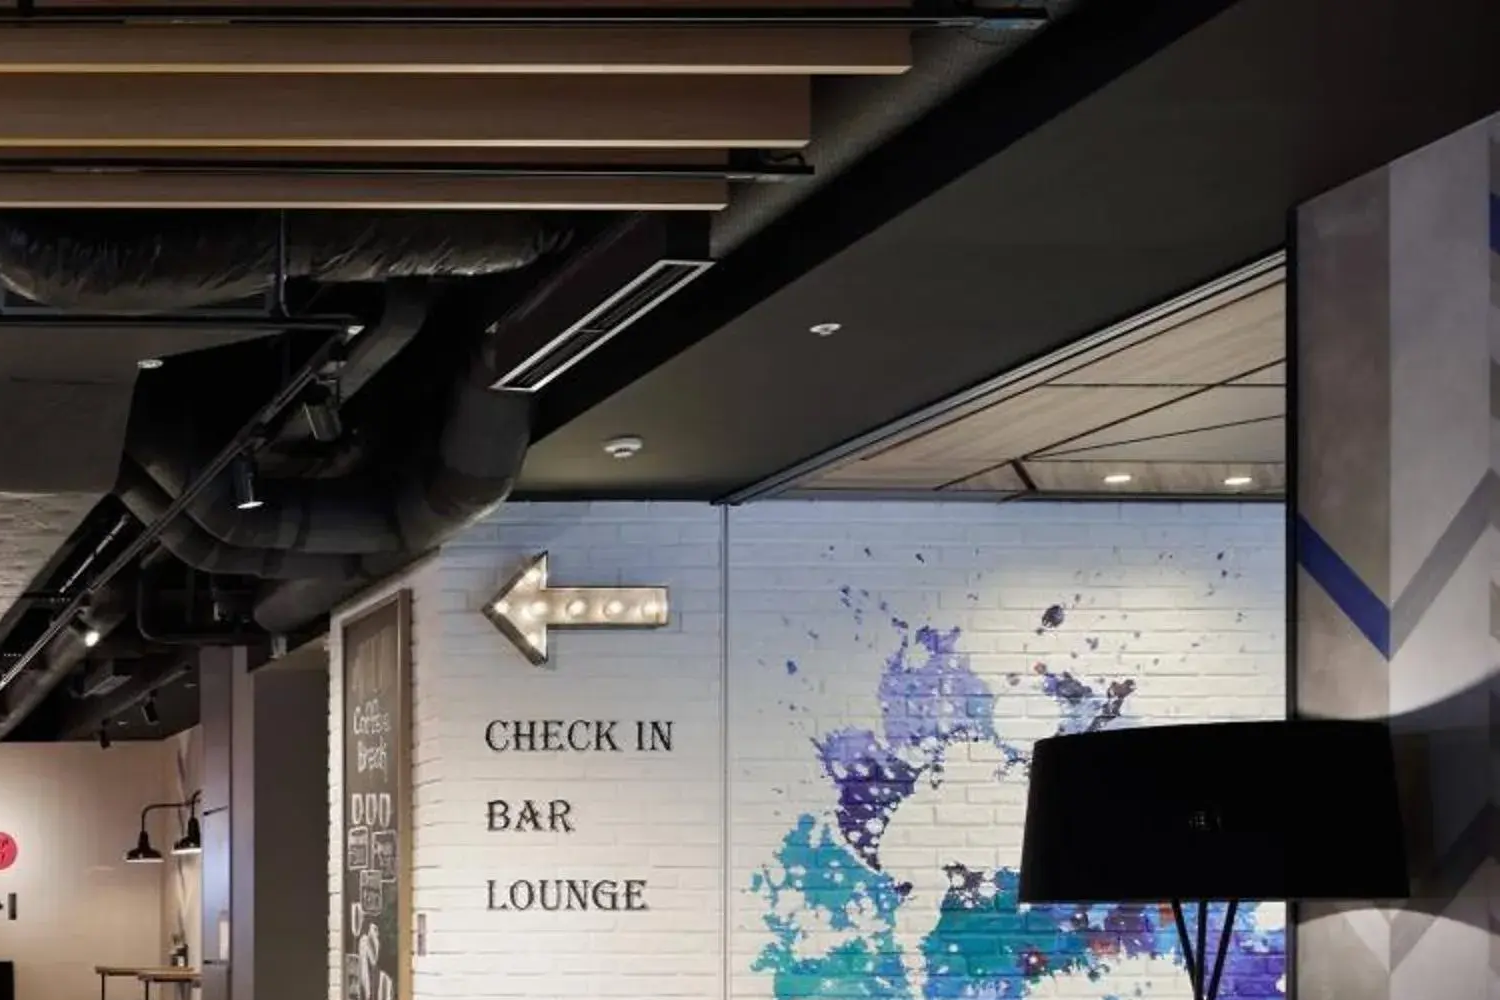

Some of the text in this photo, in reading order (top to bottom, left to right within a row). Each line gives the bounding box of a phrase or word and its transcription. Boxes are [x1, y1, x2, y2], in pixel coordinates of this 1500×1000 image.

[485, 720, 674, 752] CHECK IN
[486, 799, 575, 833] BAR
[486, 879, 649, 911] LOUNGE
